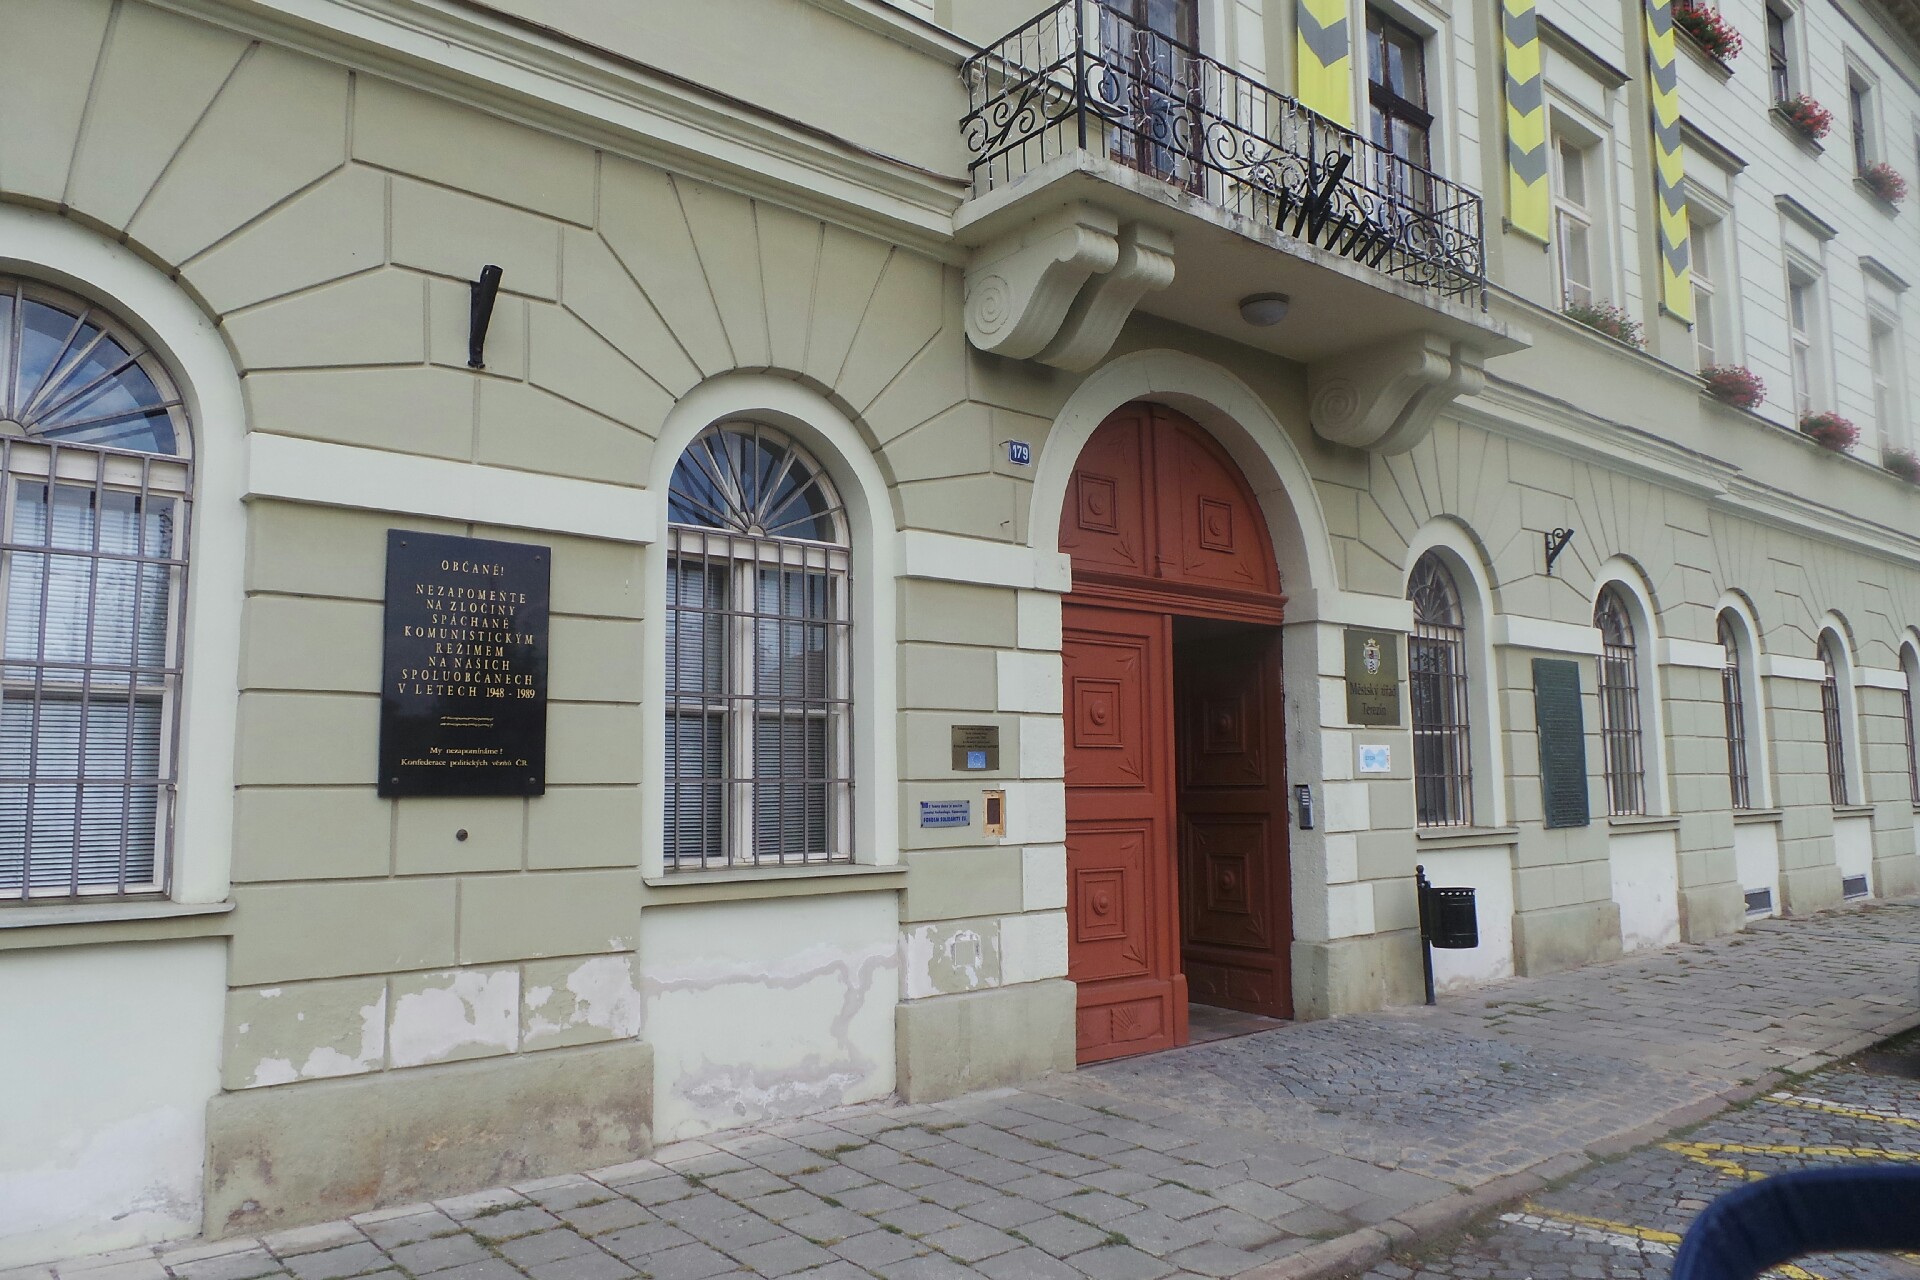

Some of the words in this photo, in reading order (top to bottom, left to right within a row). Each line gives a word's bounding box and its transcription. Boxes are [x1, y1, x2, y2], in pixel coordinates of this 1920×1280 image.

[1012, 444, 1028, 460] 179
[441, 559, 505, 576] OBČANÉ!
[415, 583, 526, 604] NEZAPOMEŇTE
[426, 599, 442, 611] NA
[450, 601, 516, 616] ZLOČINY
[431, 613, 509, 629] SPÁCHANÉ
[404, 626, 533, 645] KOMUNISTICKÝM
[436, 642, 504, 657] REŽIMEM
[428, 657, 446, 667] NA
[454, 657, 510, 671] NAŠICH
[402, 668, 533, 686] SPOLUOBČANECH
[398, 683, 406, 694] V
[415, 684, 477, 697] LETECH
[485, 687, 505, 698] 1948
[517, 688, 535, 699] 1989
[429, 747, 443, 755] My
[400, 758, 446, 766] Konfederace
[449, 759, 488, 768] politických
[515, 758, 528, 767] ČR
